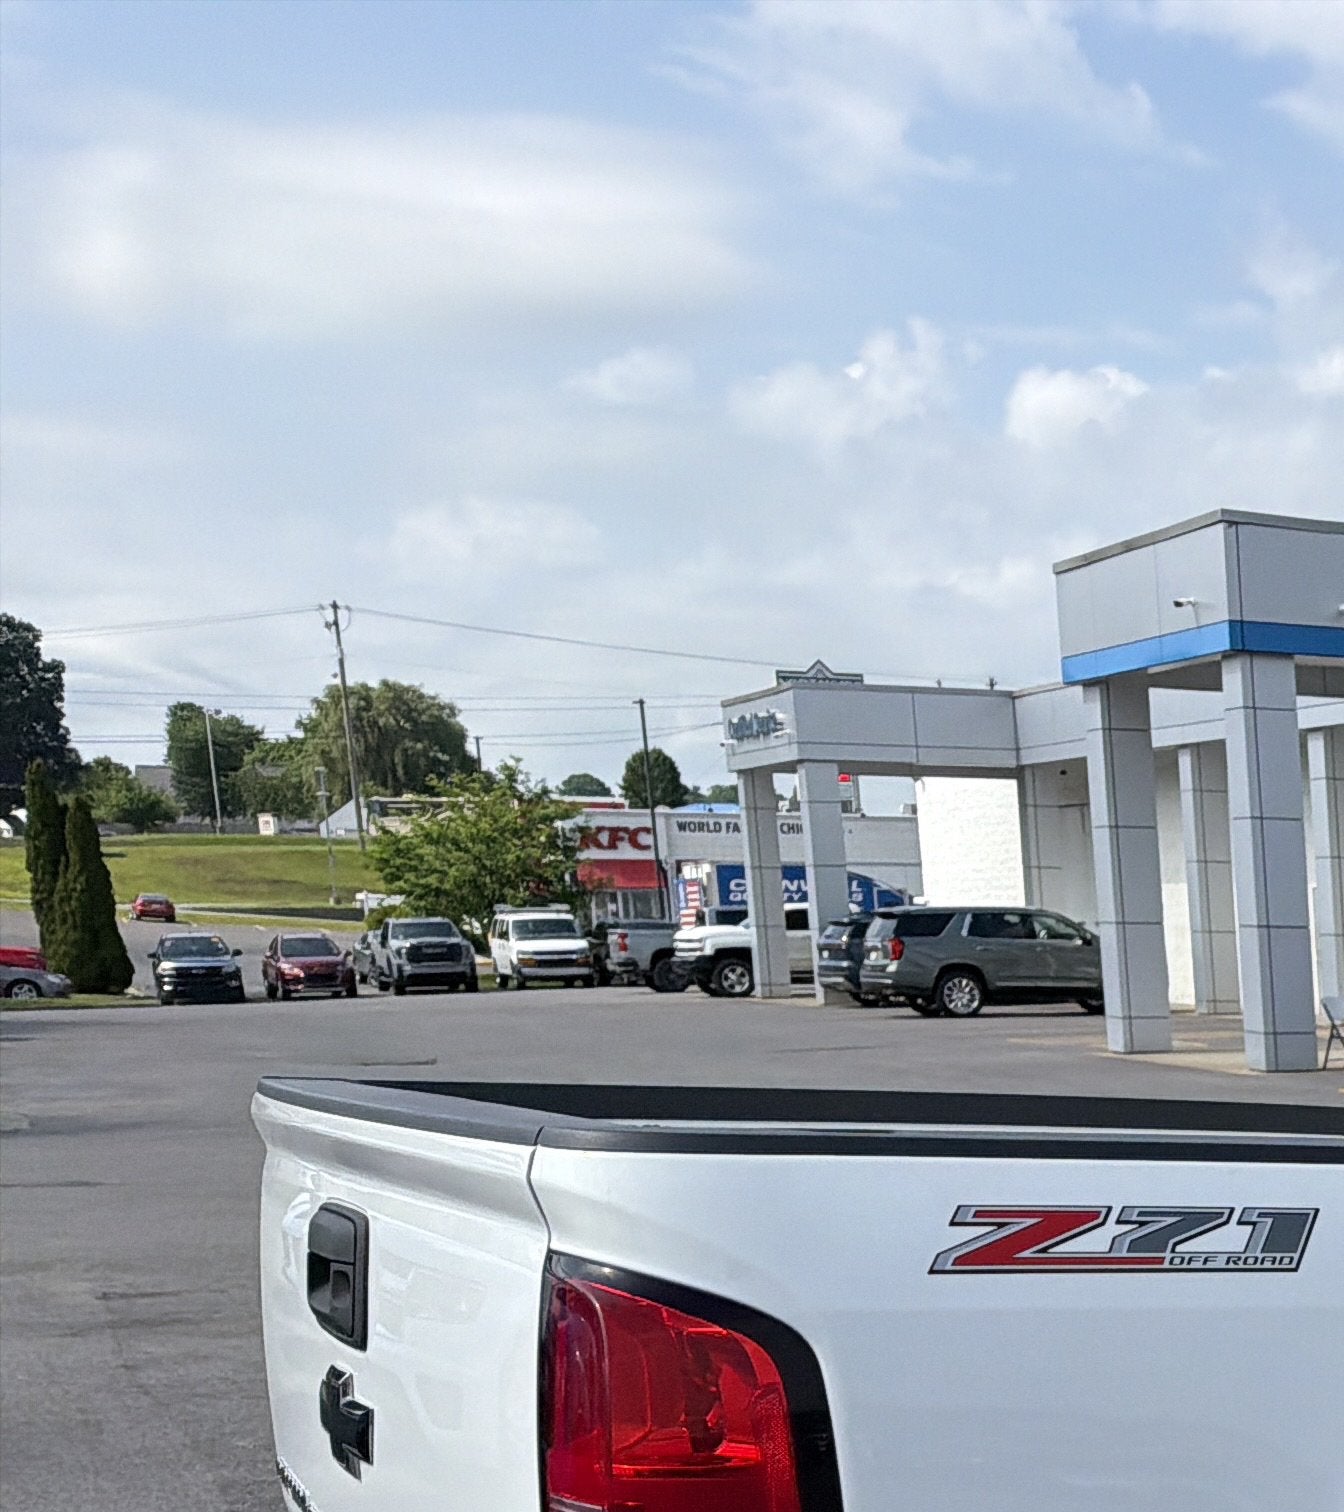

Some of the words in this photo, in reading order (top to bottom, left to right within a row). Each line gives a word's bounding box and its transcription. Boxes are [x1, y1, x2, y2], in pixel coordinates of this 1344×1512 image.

[676, 820, 722, 834] WORLD
[577, 826, 652, 851] KFC
[928, 1205, 1320, 1275] Z71
[1168, 1255, 1219, 1267] OFF
[1225, 1255, 1295, 1267] ROAD
